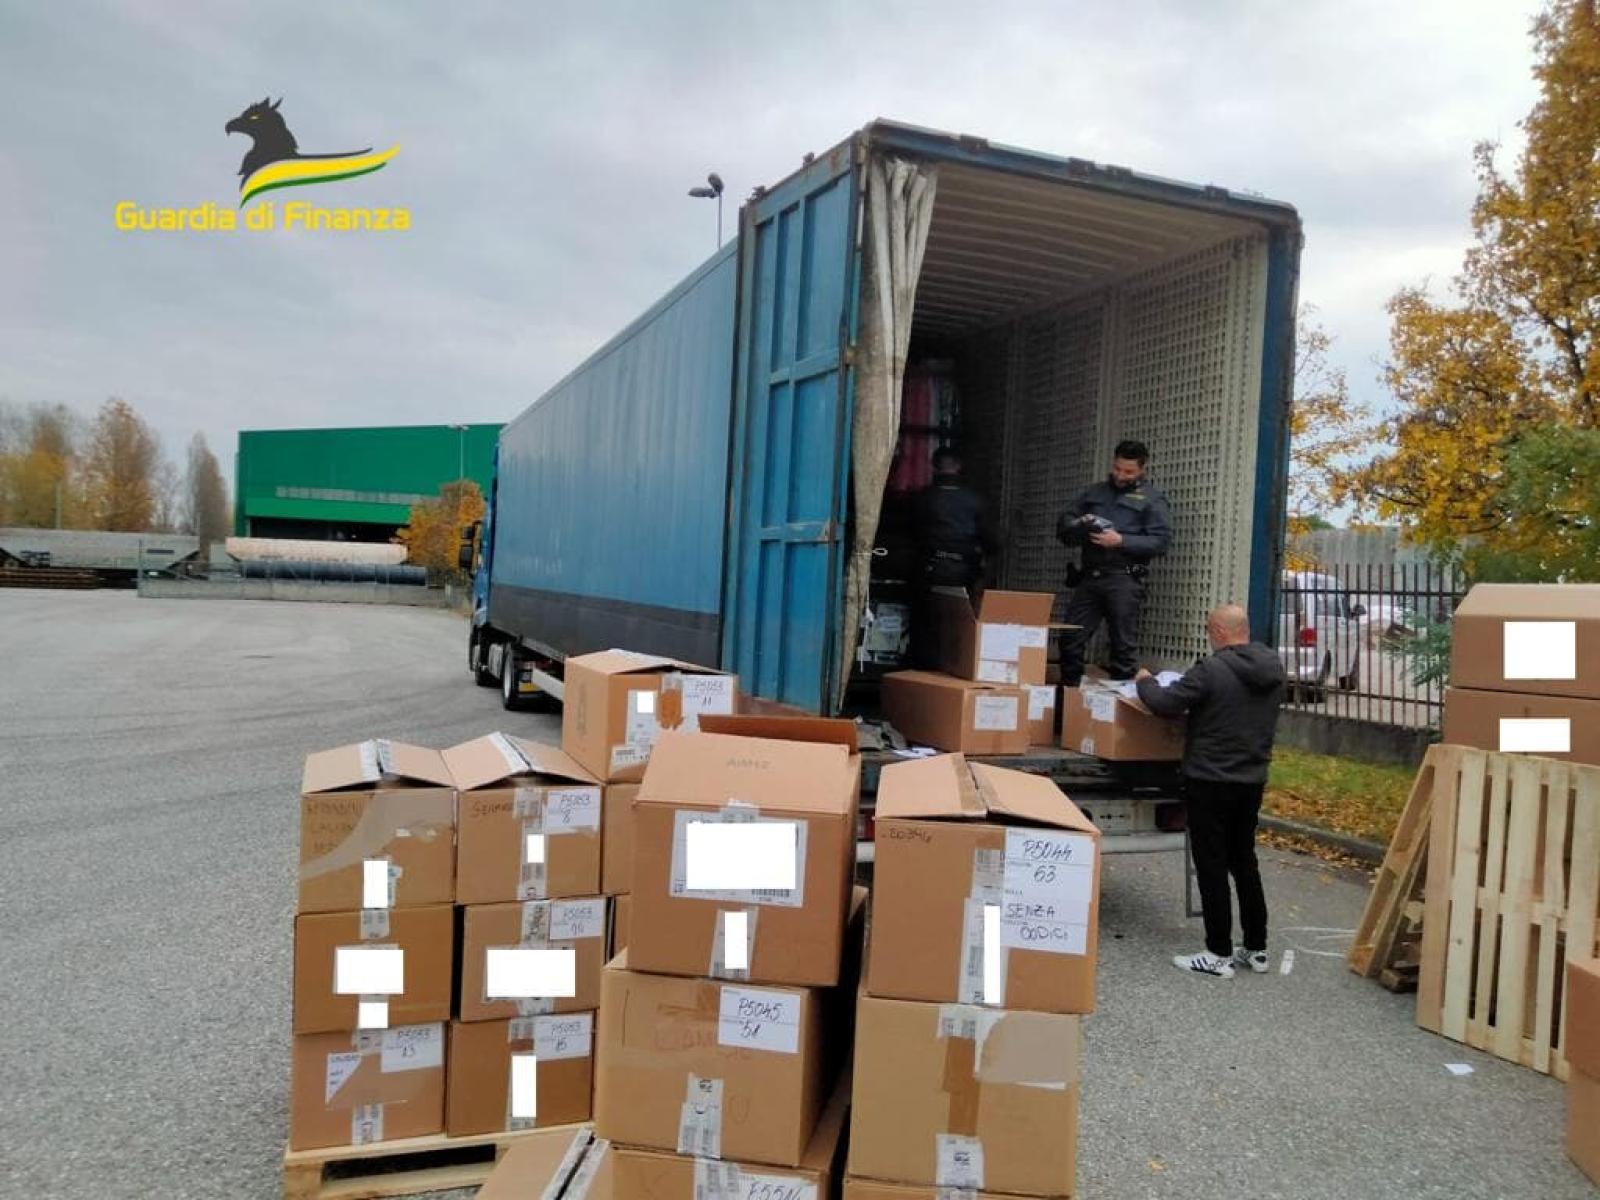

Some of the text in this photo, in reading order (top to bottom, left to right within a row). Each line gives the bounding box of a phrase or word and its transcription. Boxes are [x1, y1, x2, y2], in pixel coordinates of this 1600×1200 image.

[1034, 864, 1057, 883] 63
[1005, 902, 1056, 919] SENZA
[737, 998, 783, 1020] P5045
